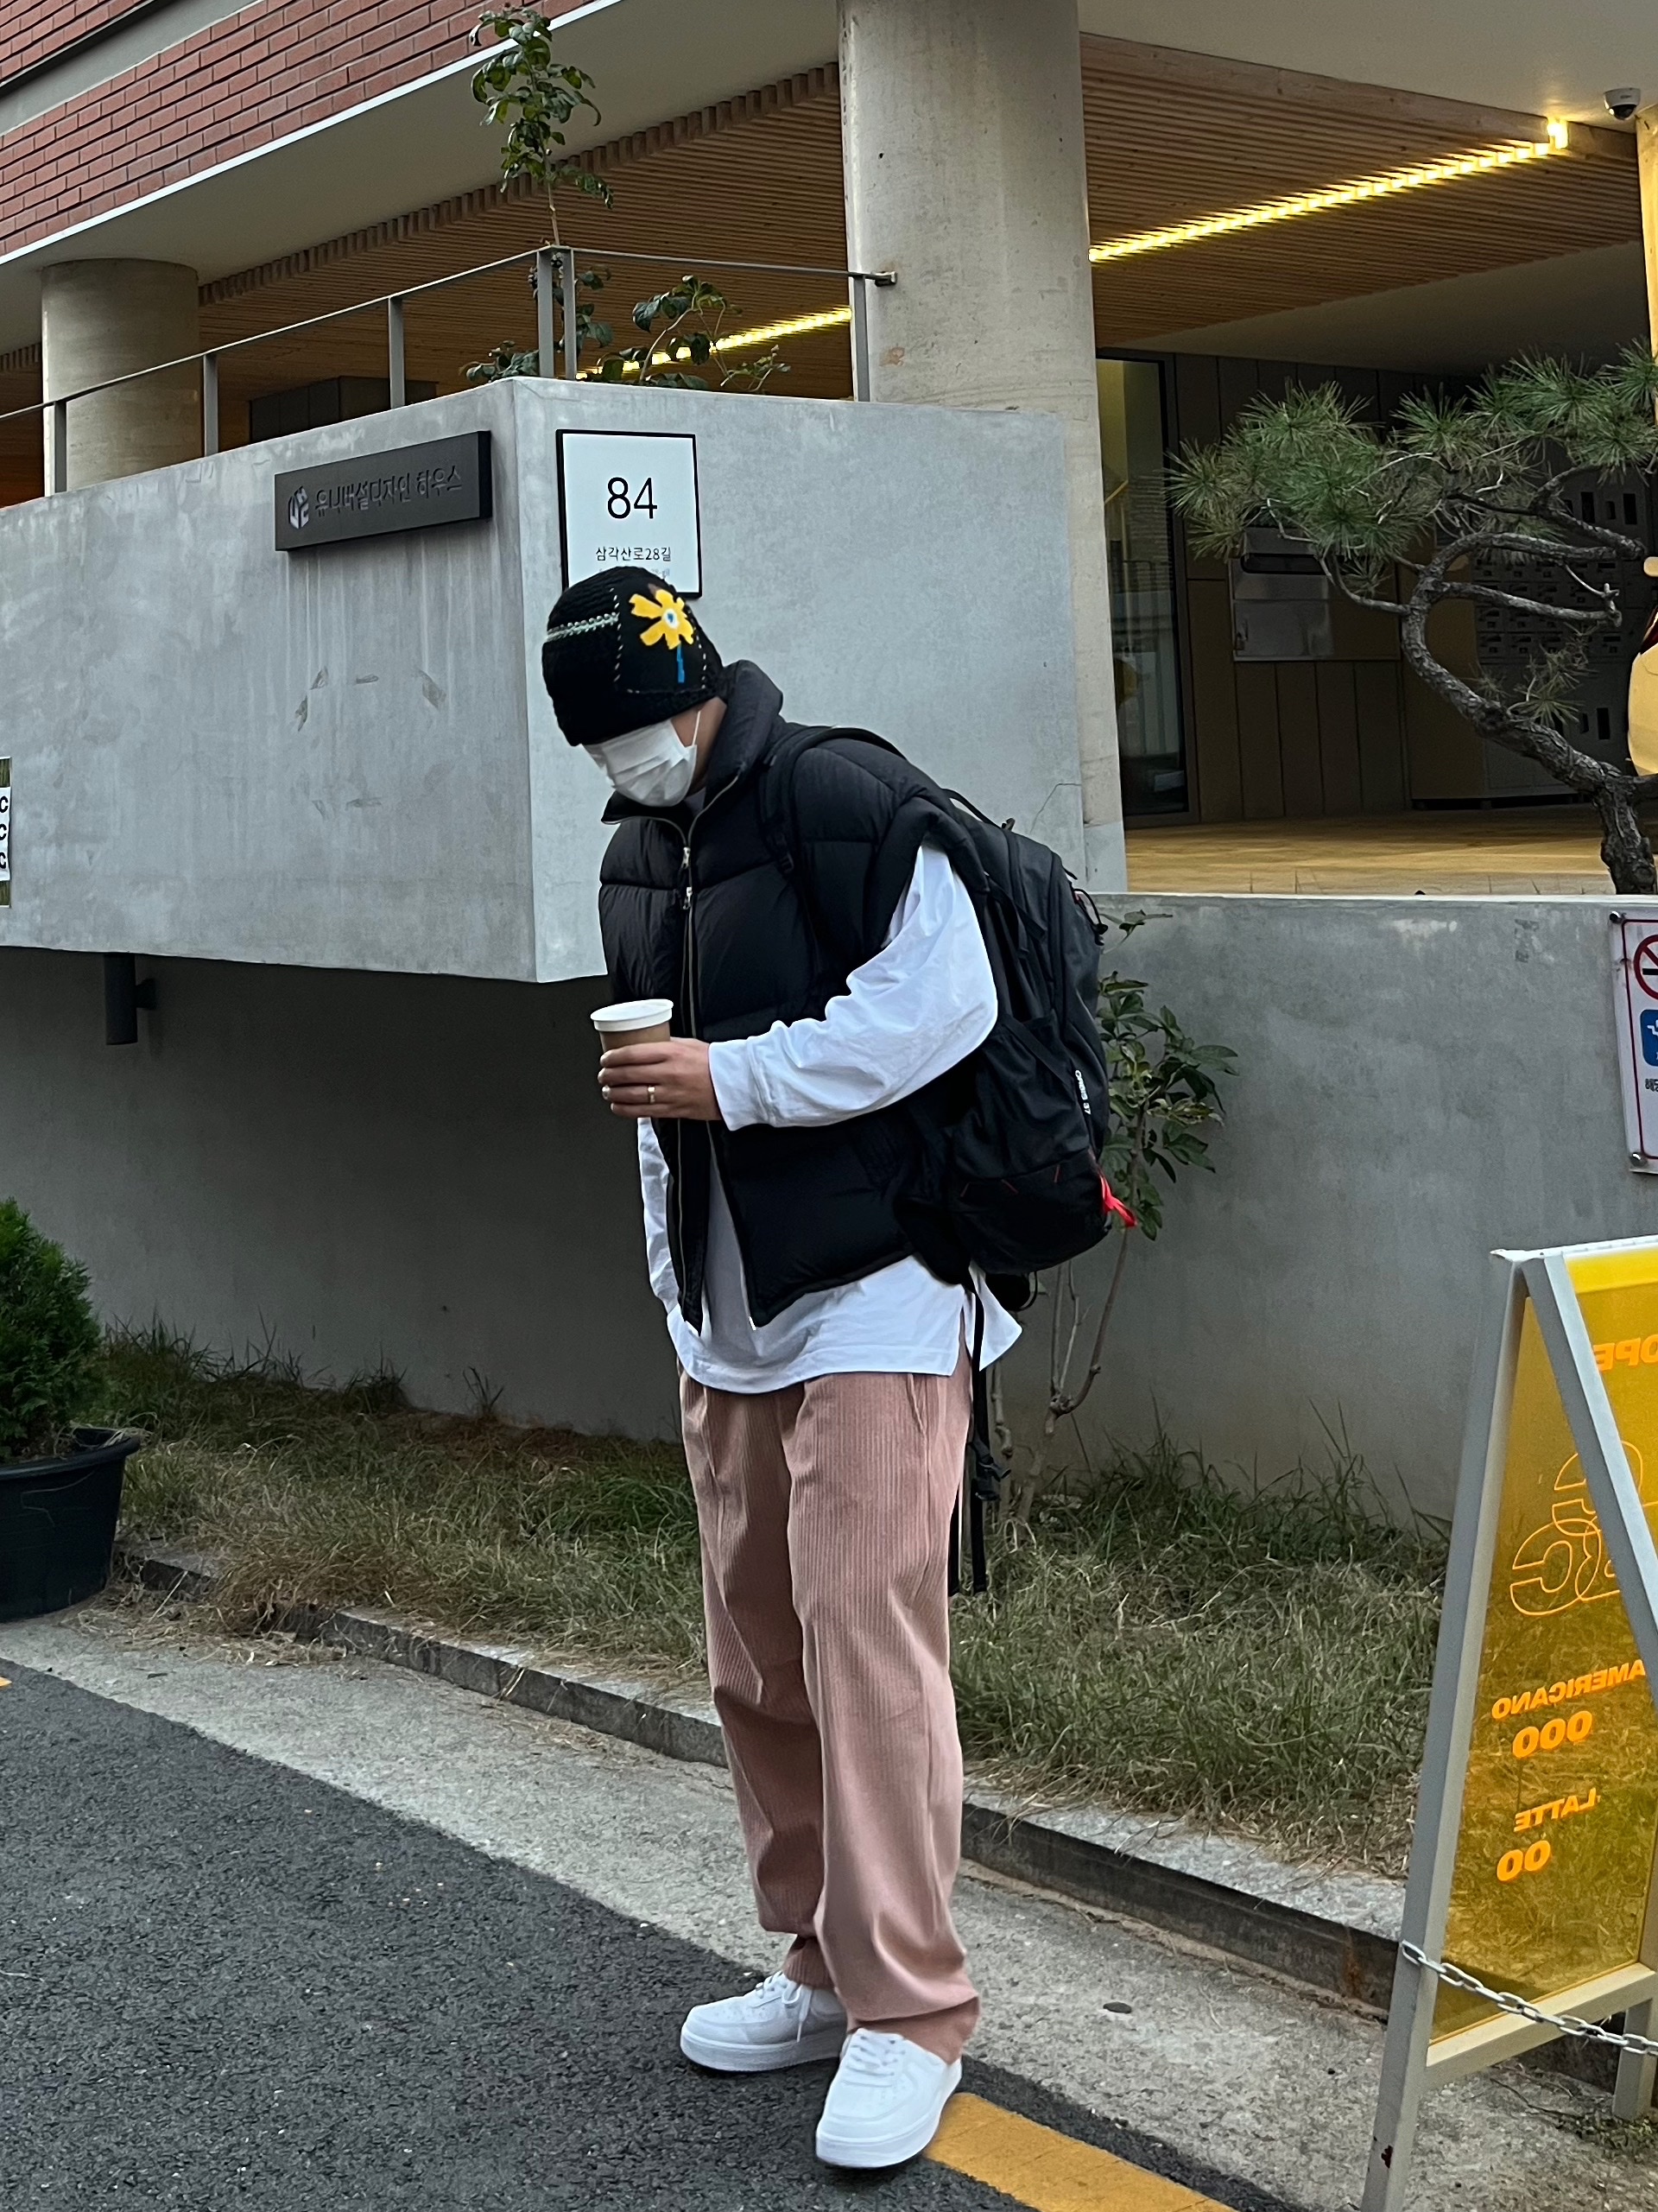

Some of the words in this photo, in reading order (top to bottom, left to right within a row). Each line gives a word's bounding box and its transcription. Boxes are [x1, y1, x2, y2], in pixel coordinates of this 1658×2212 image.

[315, 472, 411, 517] 유니버설디자인
[416, 465, 462, 498] 하우스
[607, 477, 658, 519] 84
[596, 547, 671, 562] 삼각산로28길
